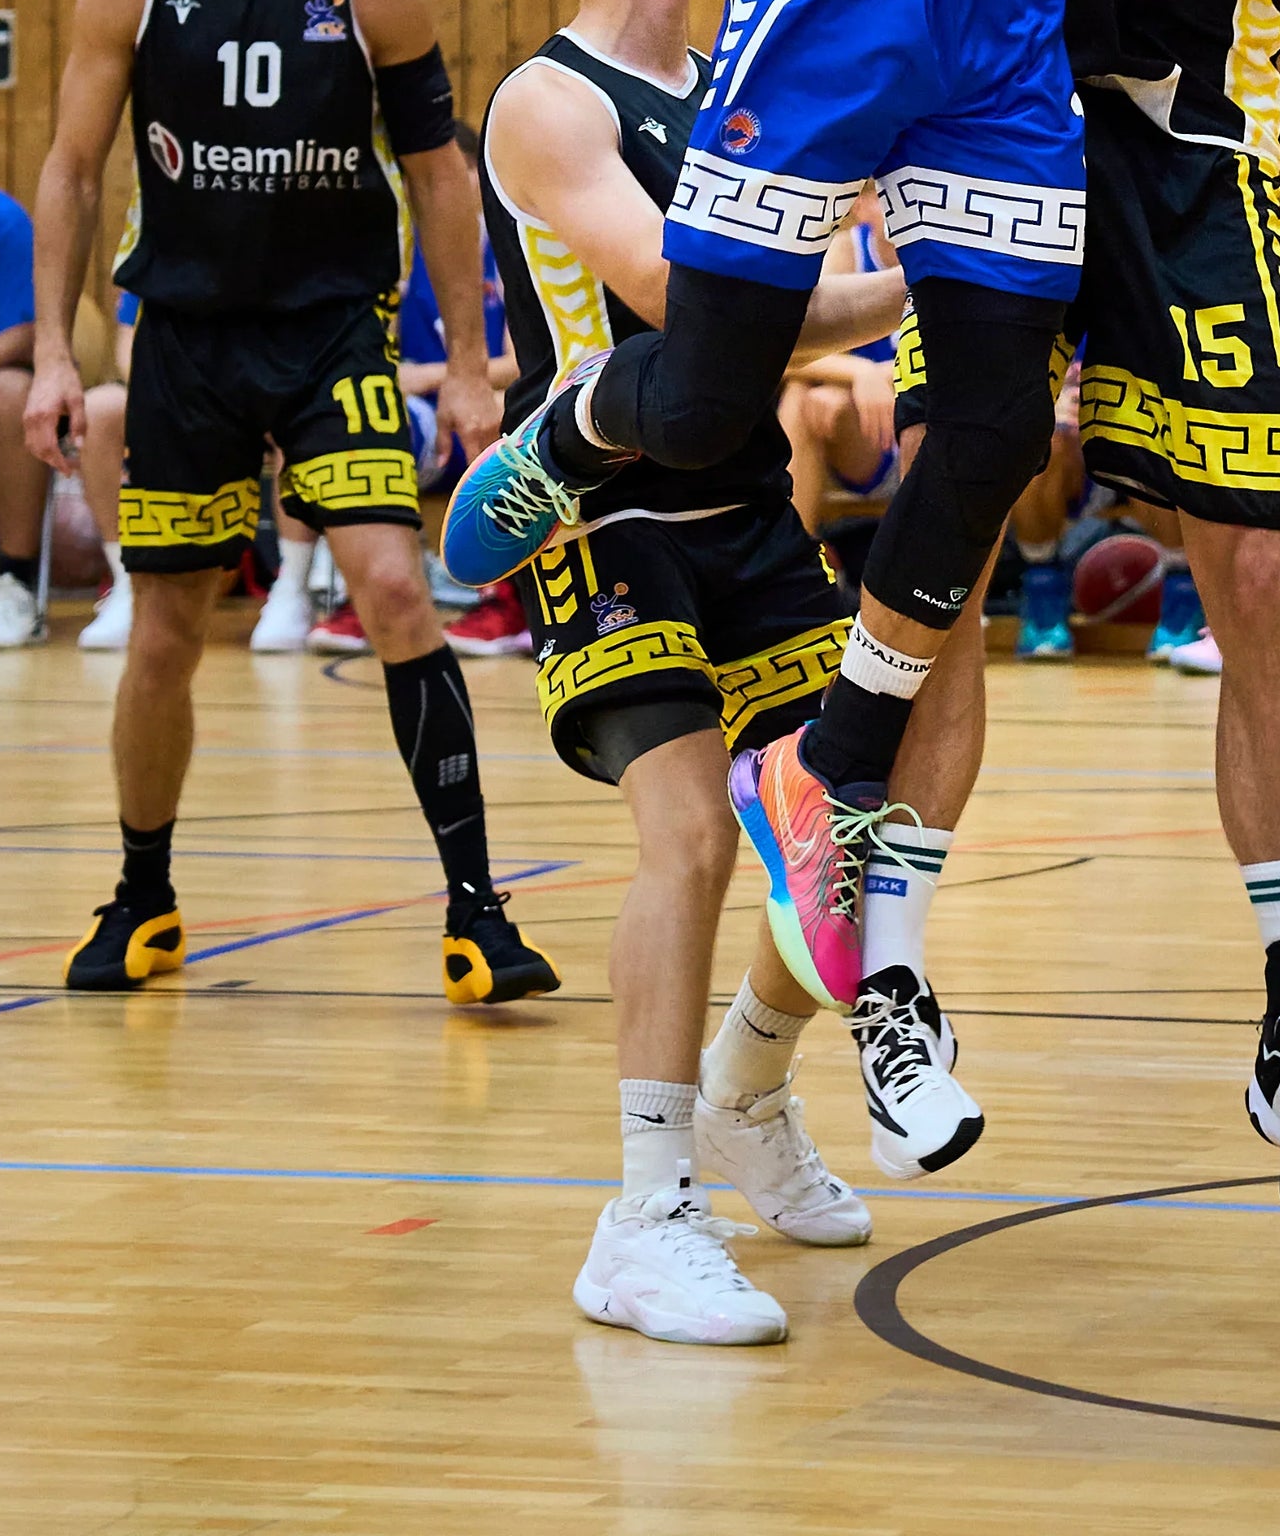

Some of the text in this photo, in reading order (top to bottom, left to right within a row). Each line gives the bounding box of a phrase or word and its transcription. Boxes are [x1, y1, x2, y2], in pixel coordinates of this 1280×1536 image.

[217, 40, 282, 107] 10
[192, 139, 360, 174] teamline
[192, 173, 363, 194] BASKETBALL
[1169, 303, 1255, 389] 15
[332, 375, 402, 435] 10
